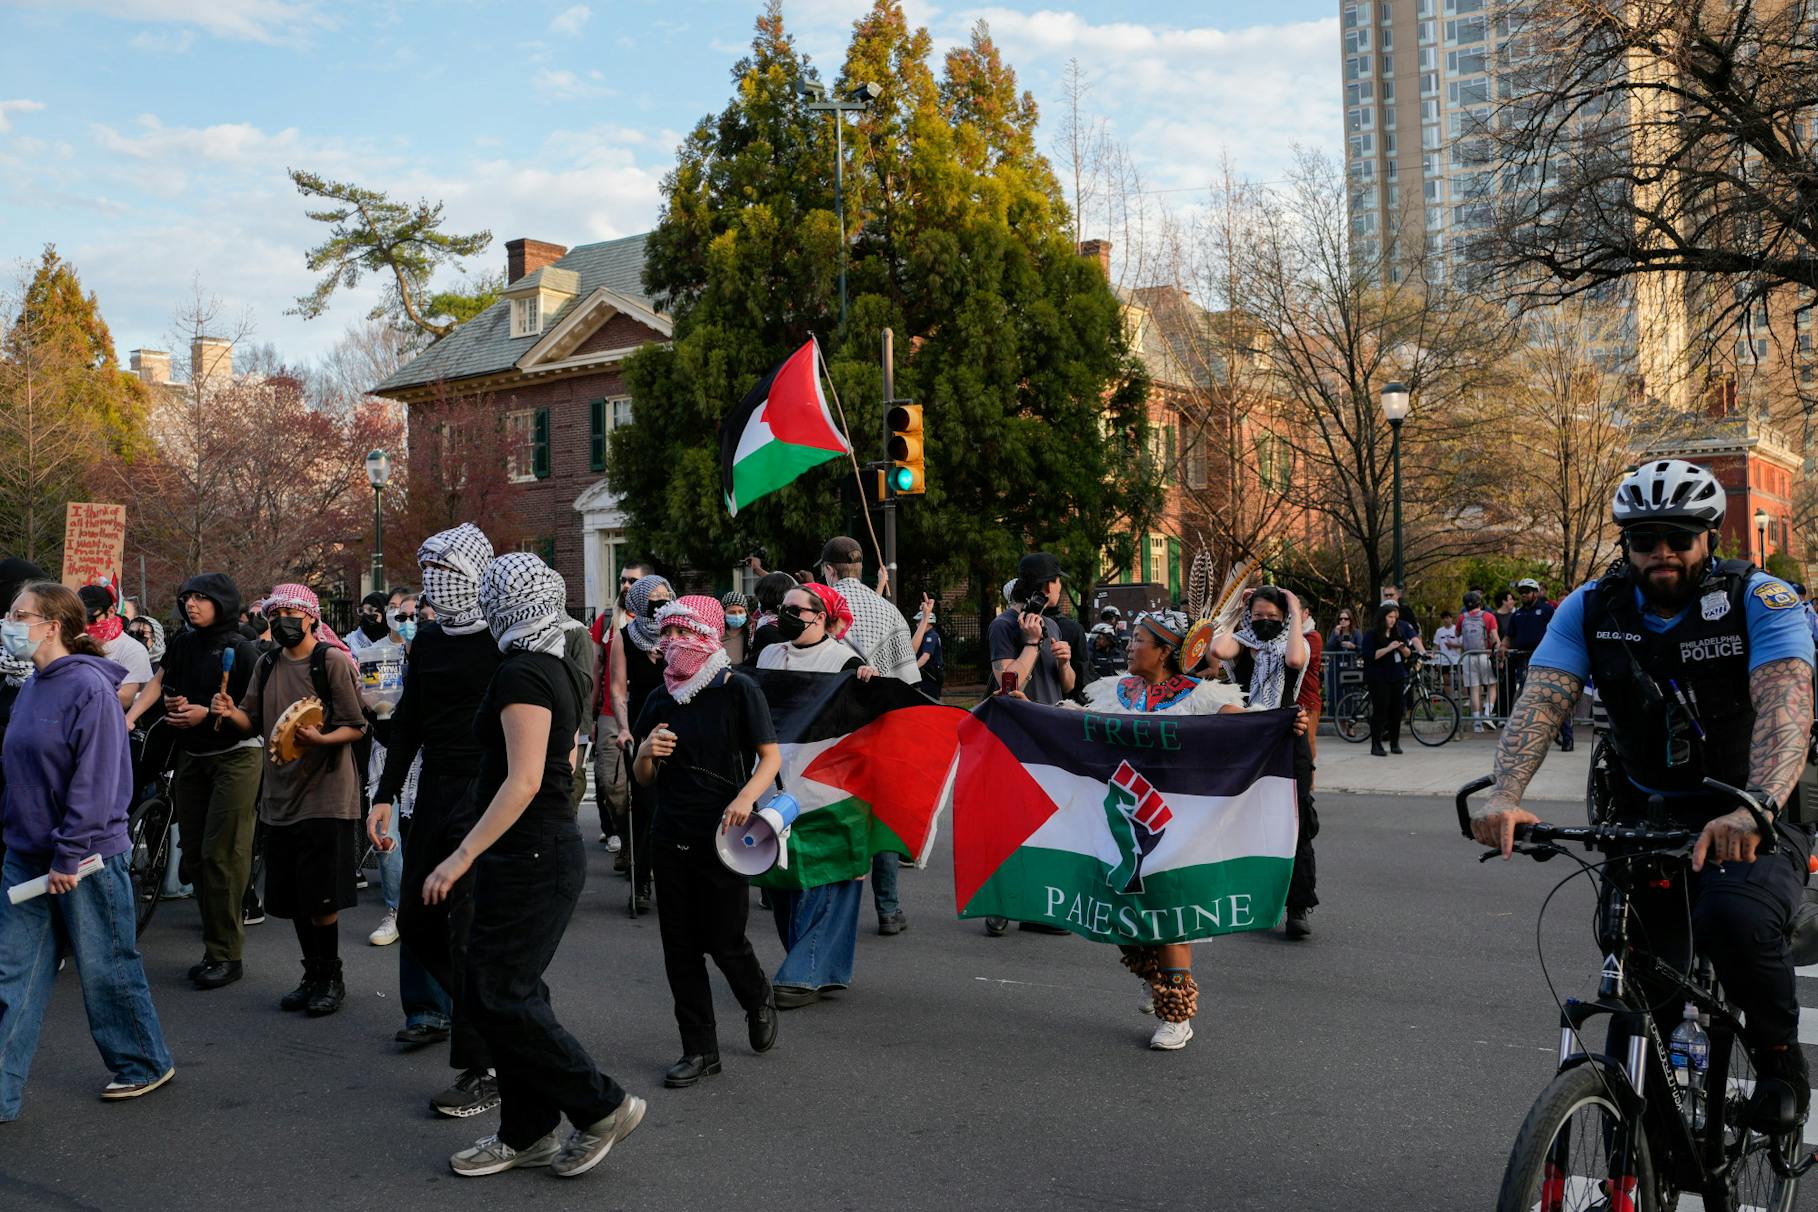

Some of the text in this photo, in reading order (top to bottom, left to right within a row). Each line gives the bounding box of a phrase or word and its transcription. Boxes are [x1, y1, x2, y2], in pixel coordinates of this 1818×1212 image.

[71, 504, 121, 518] I think of
[70, 518, 84, 527] all
[66, 539, 74, 550] I
[1596, 630, 1642, 642] DELGDO
[1680, 634, 1742, 650] PHILADELPHIA
[1681, 642, 1744, 663] POLICE
[1083, 713, 1183, 751] FREE
